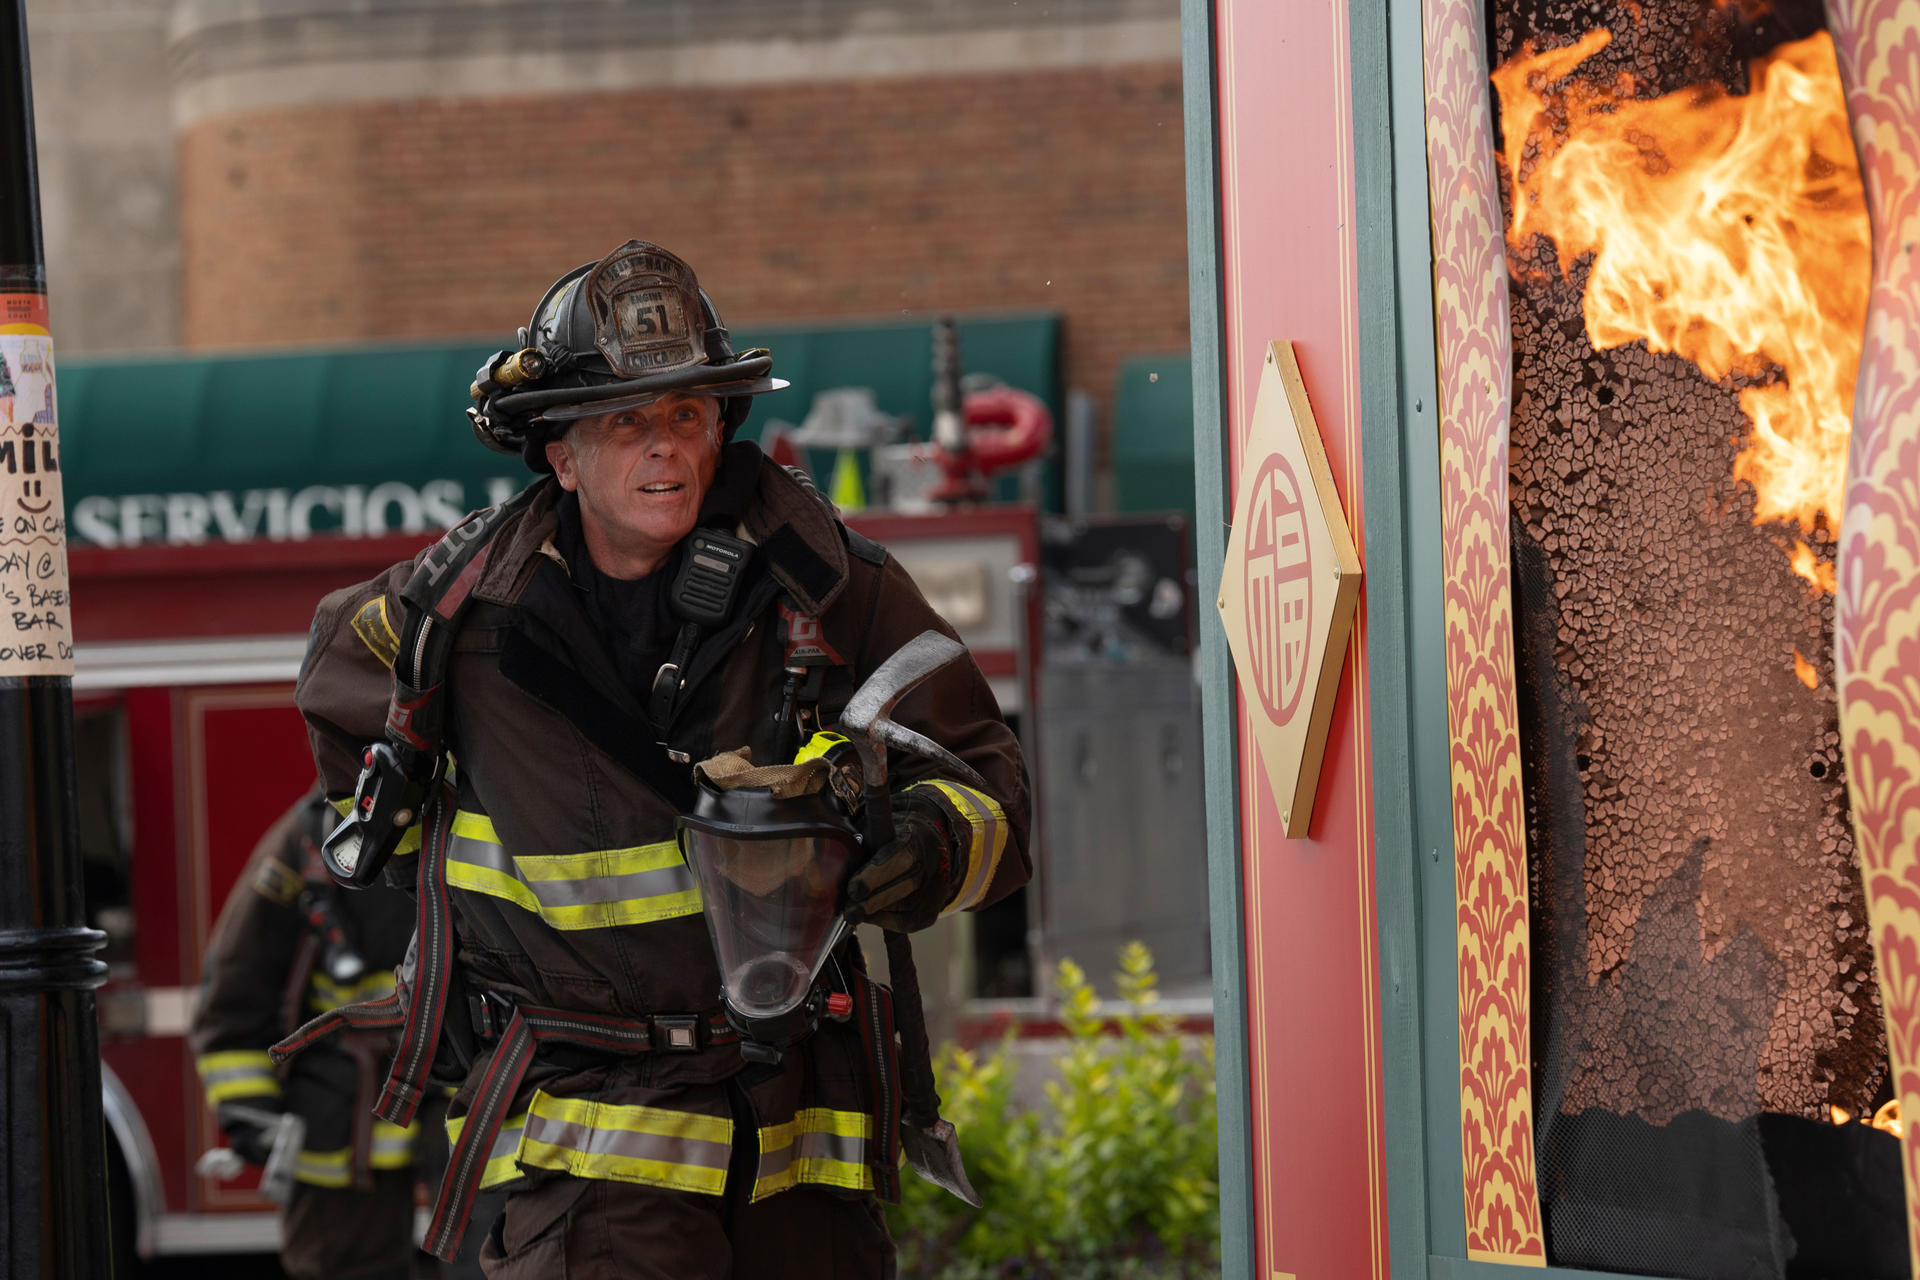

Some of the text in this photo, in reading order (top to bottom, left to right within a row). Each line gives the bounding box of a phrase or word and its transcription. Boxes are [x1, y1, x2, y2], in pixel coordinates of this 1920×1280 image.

[636, 304, 671, 335] 51
[73, 479, 466, 548] SERVICIOS
[706, 544, 739, 558] MOTOROLA
[12, 611, 63, 631] BAR
